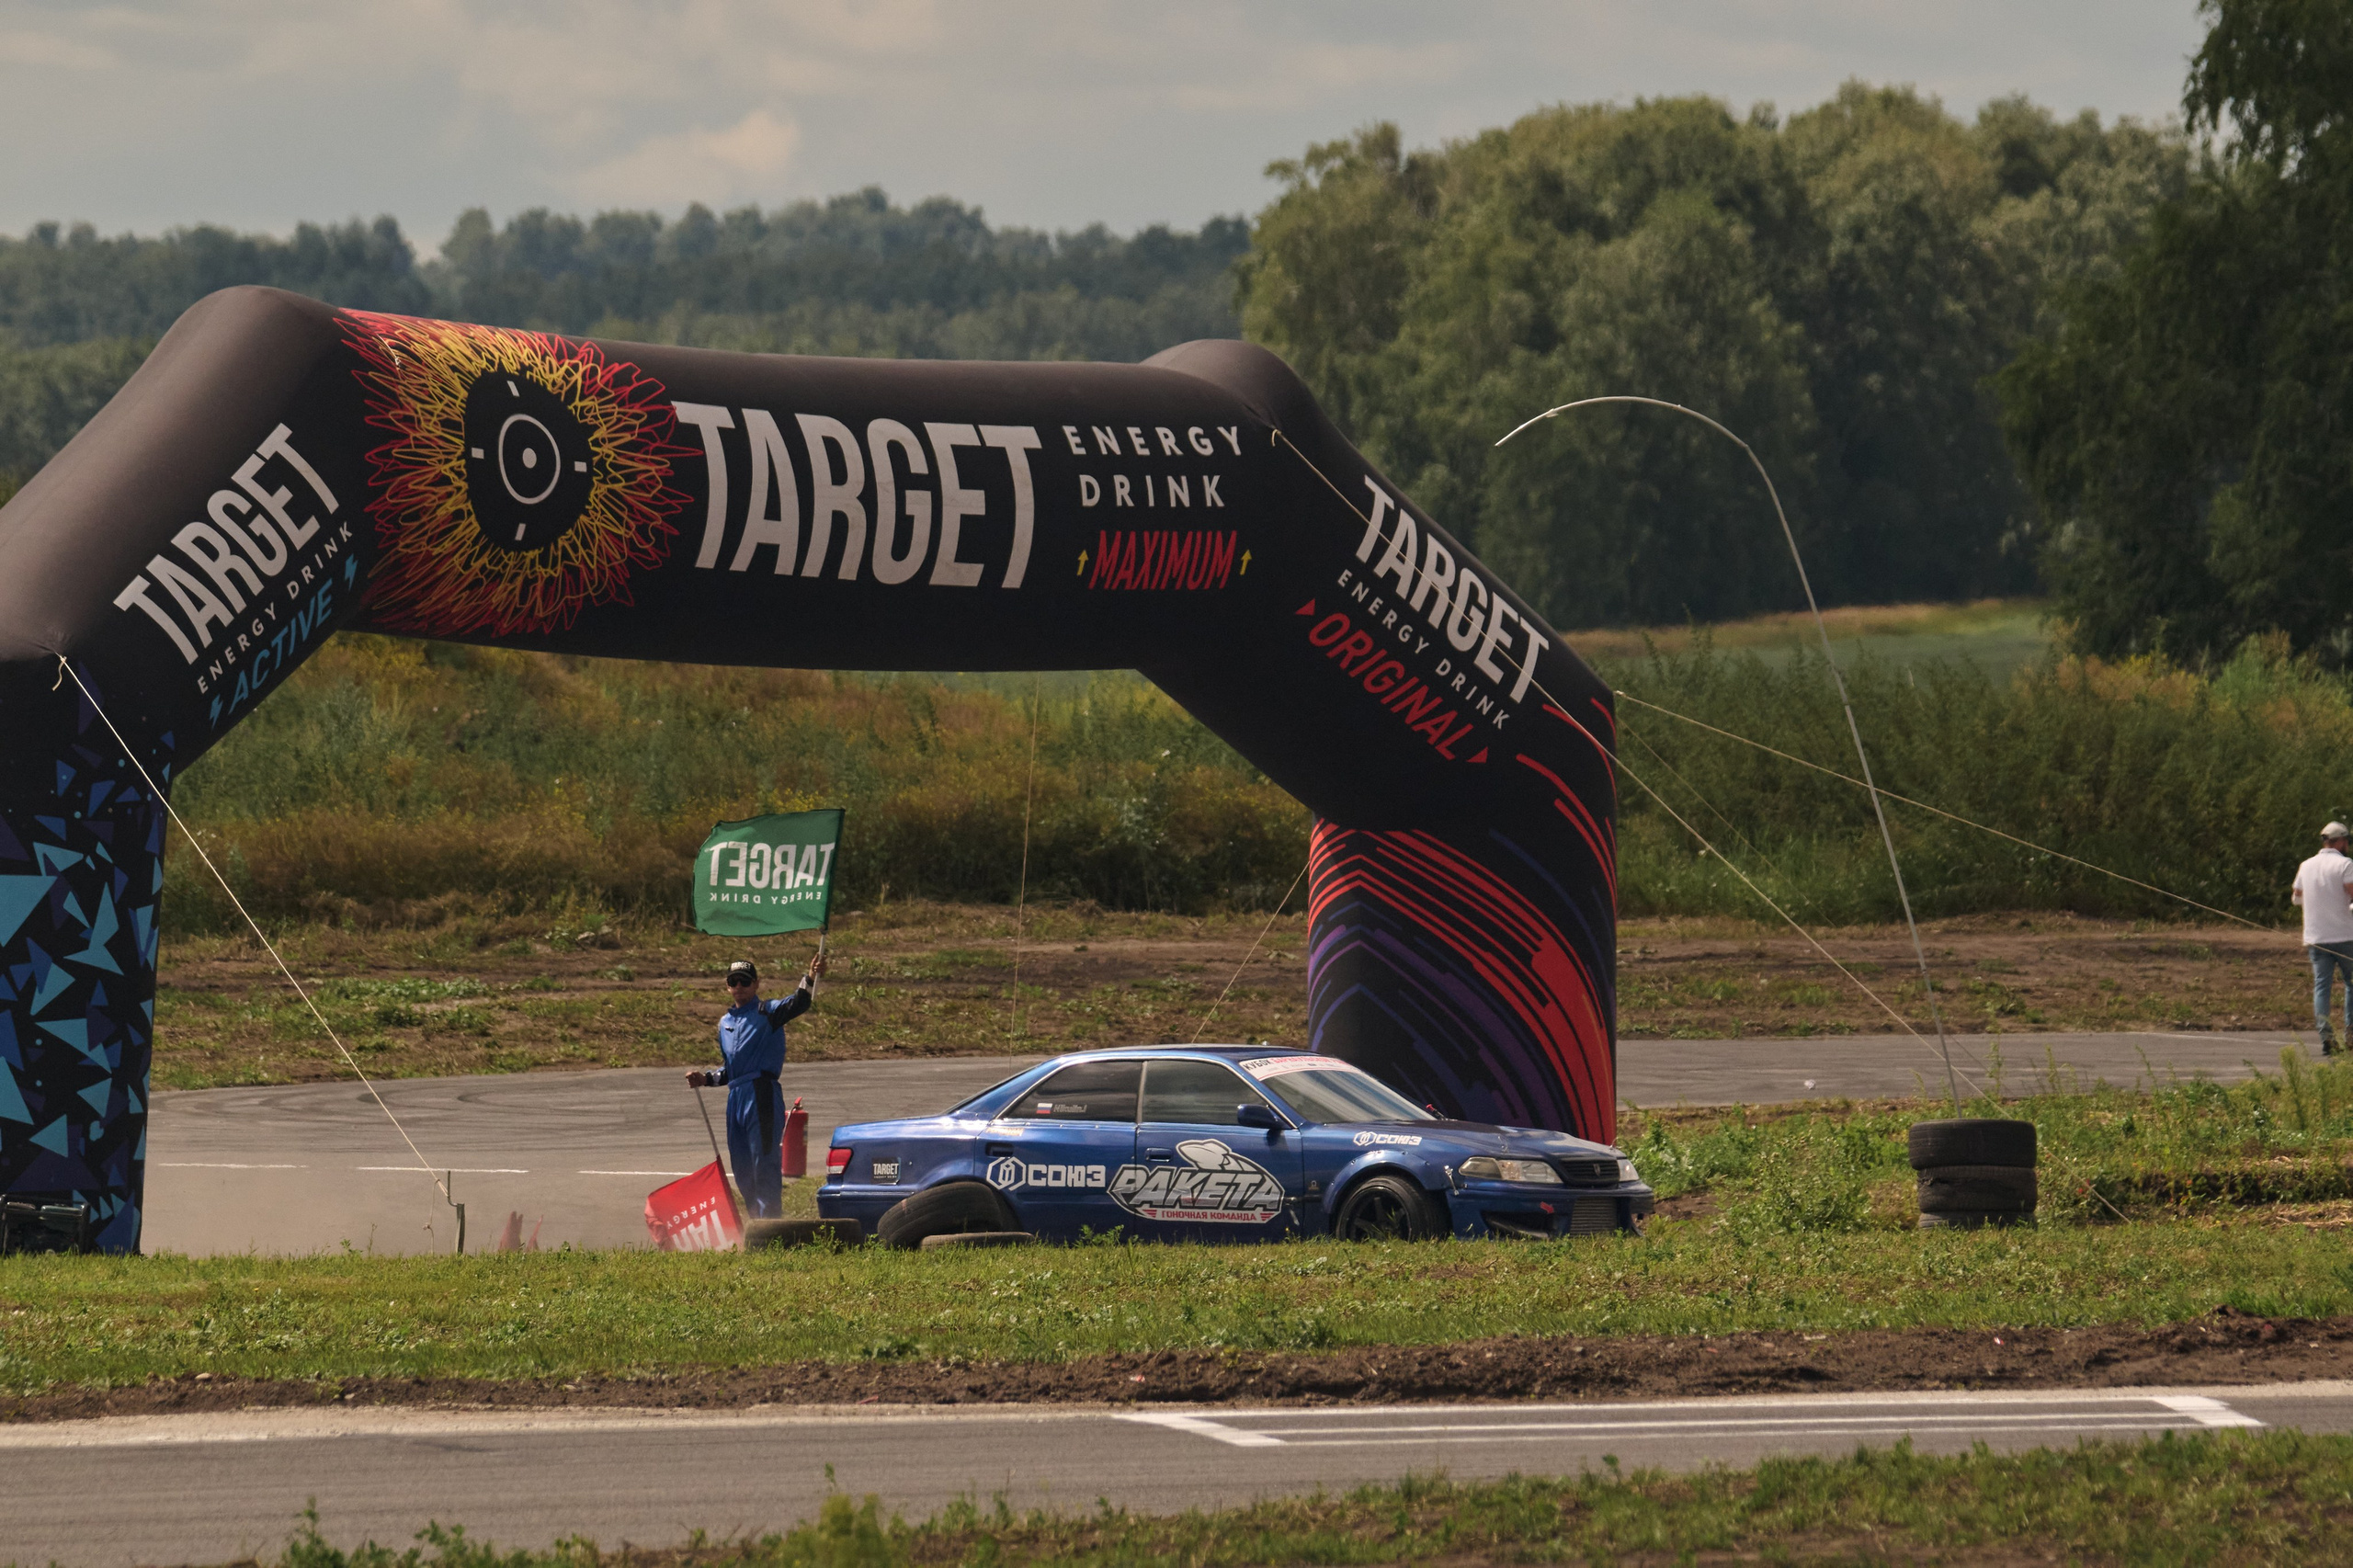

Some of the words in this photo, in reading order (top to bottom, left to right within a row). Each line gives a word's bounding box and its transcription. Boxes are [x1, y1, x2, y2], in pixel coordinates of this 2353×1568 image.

[1061, 425, 1242, 456] ENERGY
[670, 401, 1042, 589] TARGET
[1078, 473, 1226, 507] DRINK
[113, 422, 339, 665] TARGET
[1088, 529, 1237, 590] MAXIMUM
[197, 602, 277, 694] ENERGY
[287, 521, 353, 599] DRINK
[1355, 474, 1550, 704] TARGET
[228, 579, 333, 715] ACTIVE
[1336, 569, 1429, 654] ENERGY
[1435, 658, 1510, 730] DRINK
[1308, 612, 1474, 761] ORIGINAL
[1243, 1059, 1272, 1071] КУБОК
[873, 1163, 899, 1175] TARGET
[1028, 1164, 1106, 1187] СОЮЗ
[1108, 1165, 1283, 1210] РАКЕТА
[666, 1197, 716, 1230] ENERGY
[1161, 1210, 1208, 1220] ГОНОЧНАЯ
[1210, 1211, 1257, 1221] КОМАНДА
